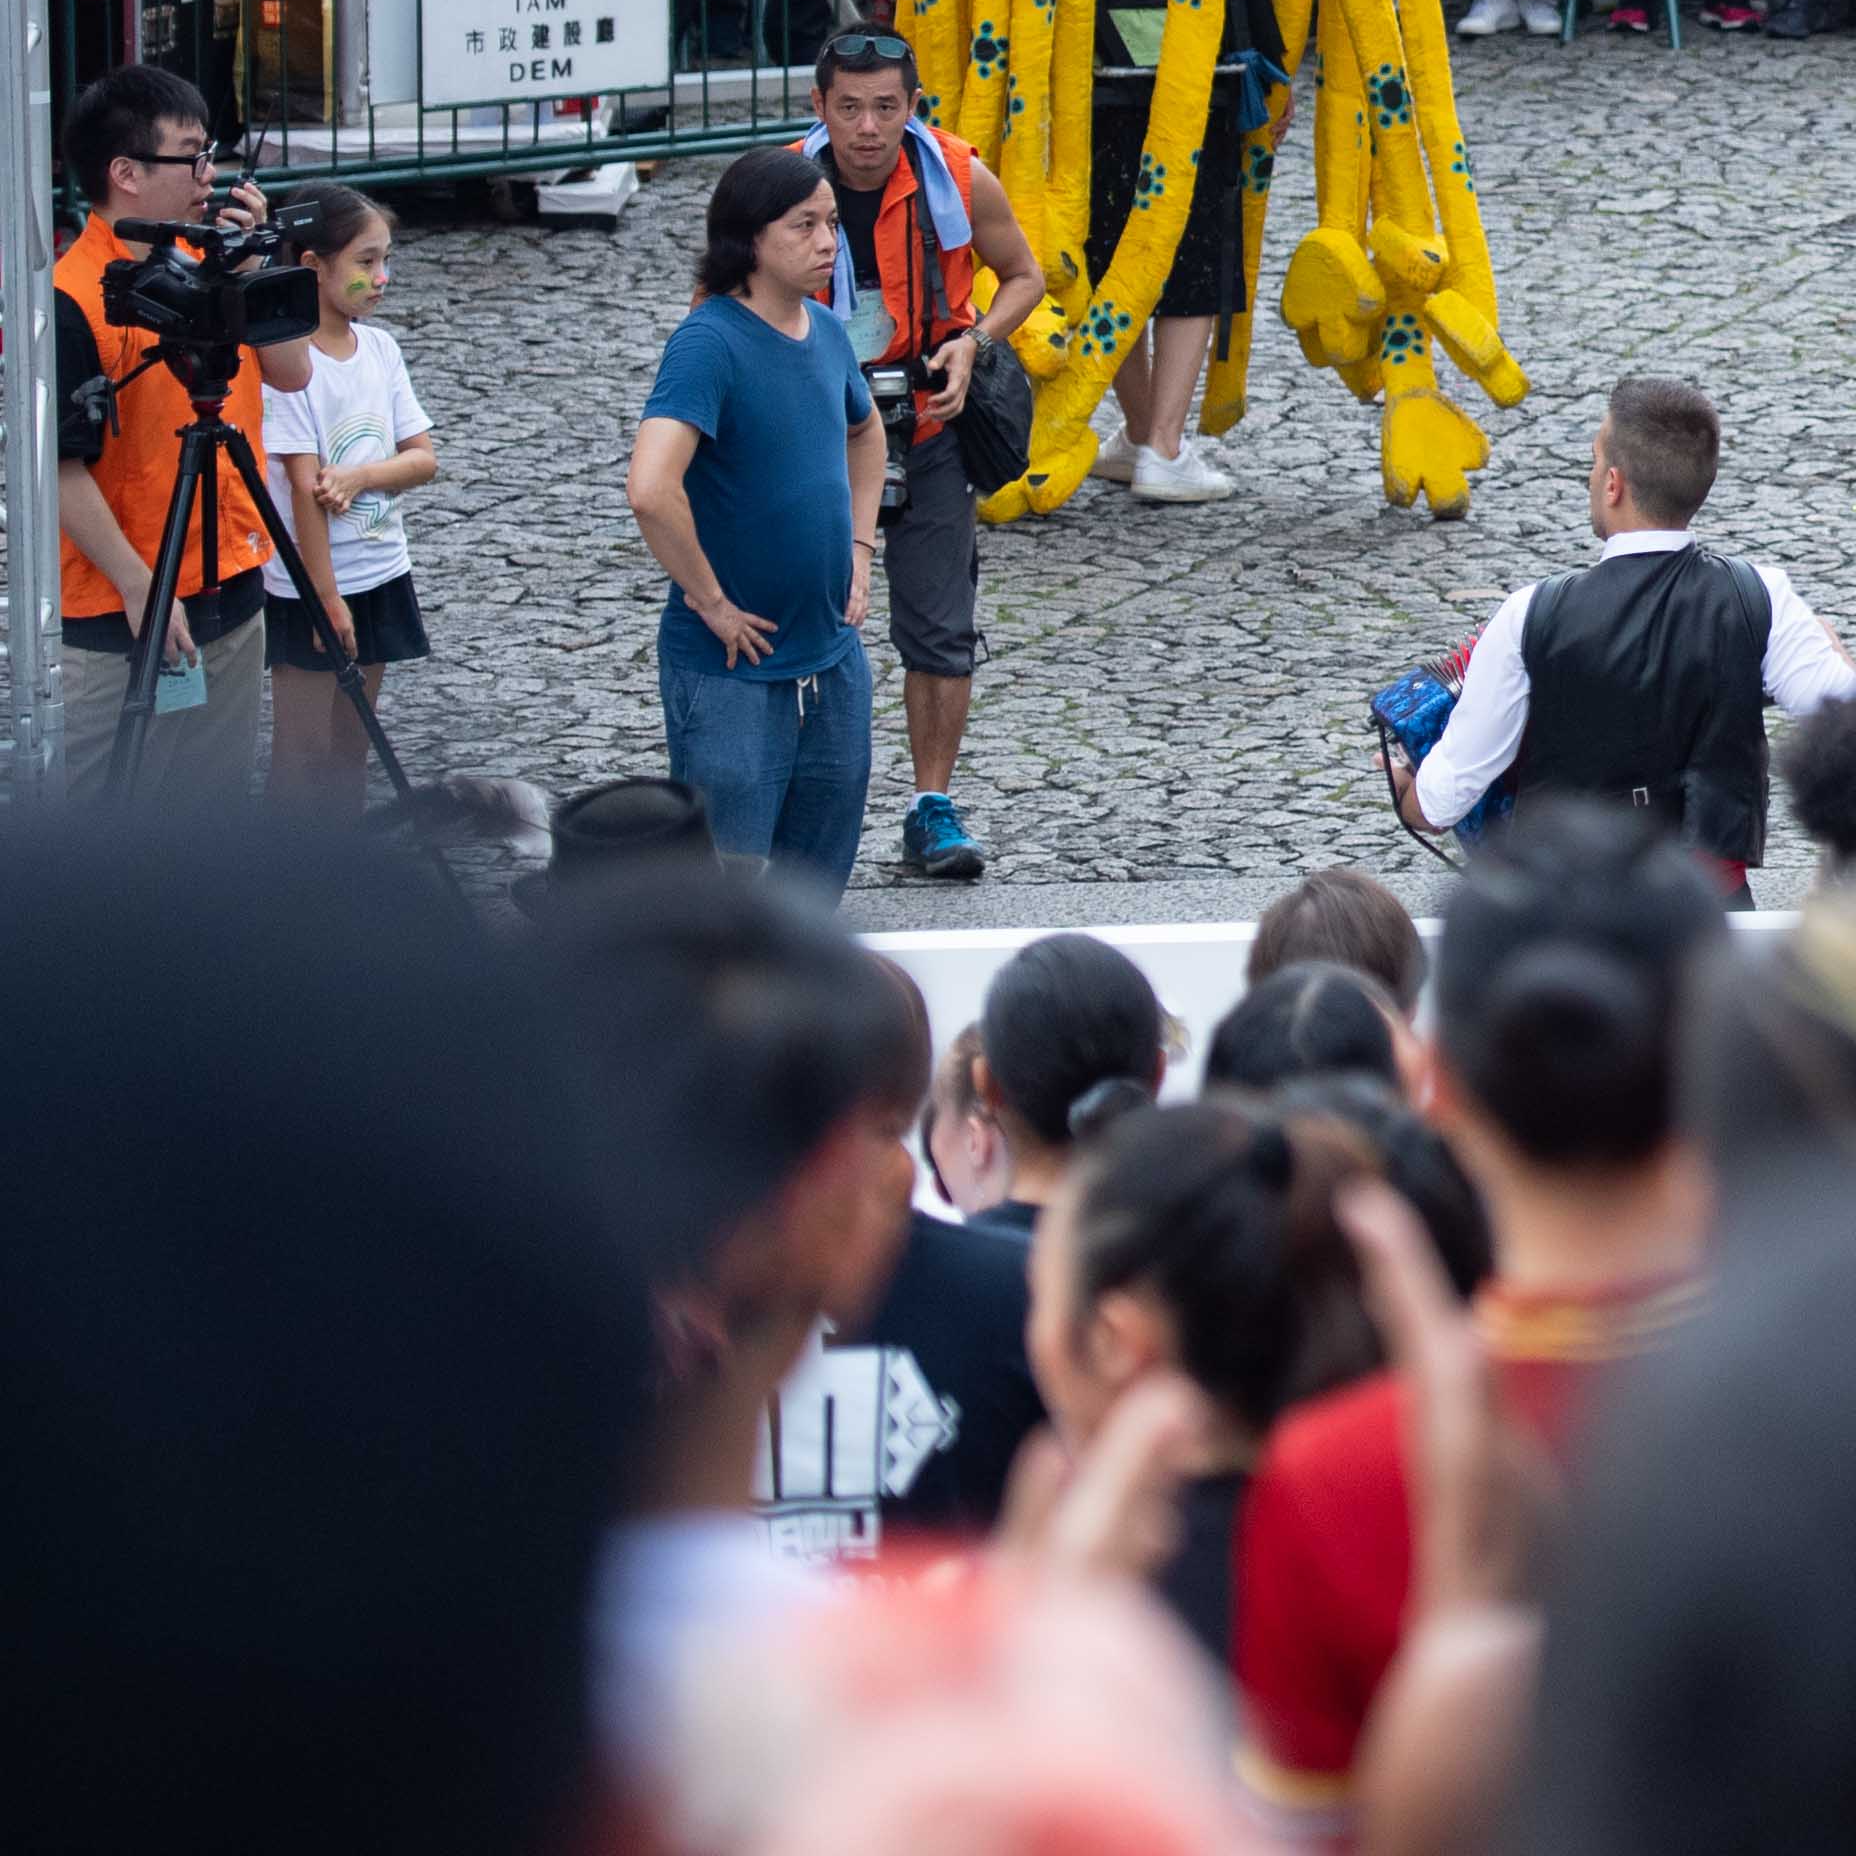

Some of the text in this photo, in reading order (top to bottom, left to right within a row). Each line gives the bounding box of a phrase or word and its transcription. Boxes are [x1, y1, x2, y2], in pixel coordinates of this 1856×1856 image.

[466, 17, 615, 55] 市政建設廳
[510, 57, 573, 83] DEM
